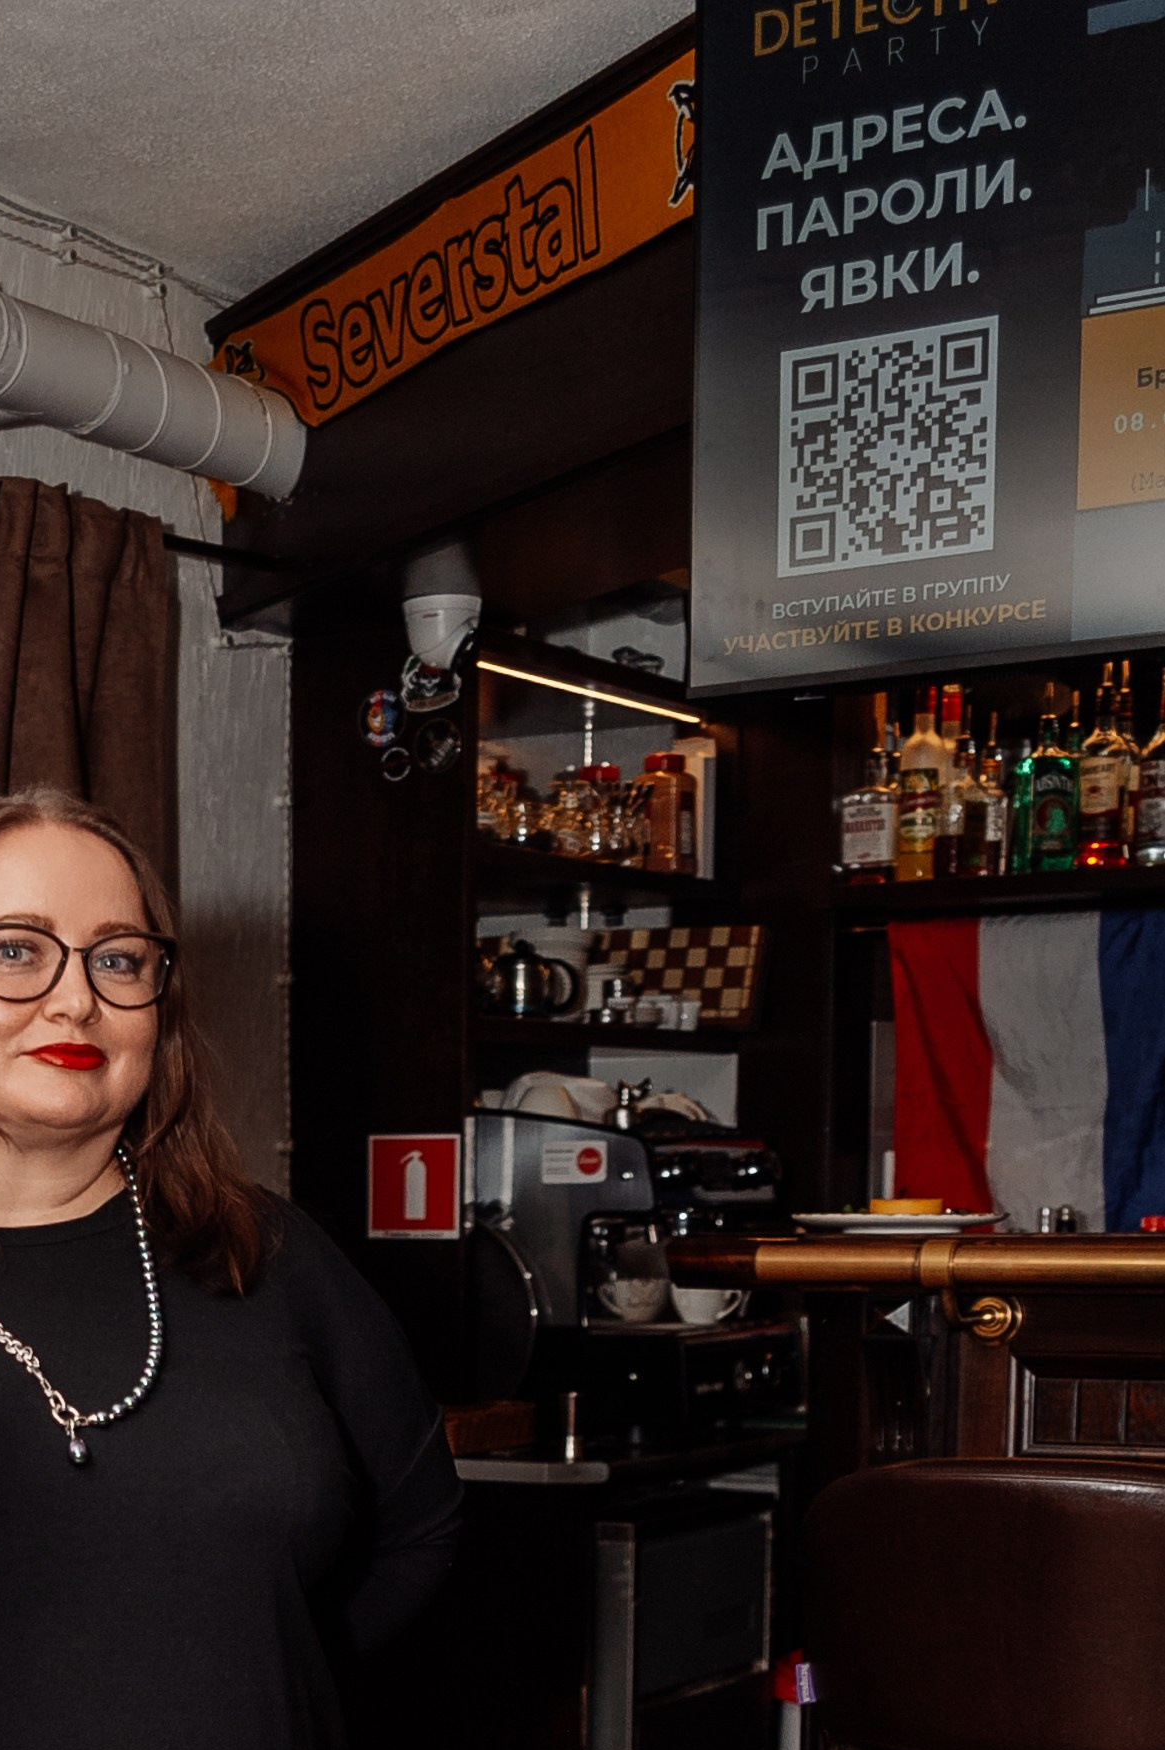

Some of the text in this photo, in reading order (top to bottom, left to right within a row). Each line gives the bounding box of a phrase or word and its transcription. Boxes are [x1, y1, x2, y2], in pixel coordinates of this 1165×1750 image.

[802, 16, 989, 84] PARTY
[761, 89, 1027, 180] АДРЕСА.
[756, 159, 1033, 251] ПАРОЛИ.
[300, 125, 600, 411] Severstal
[800, 242, 980, 313] ЯВКИ.
[724, 599, 1047, 656] УЧАСТВУЙТЕ В КОНКУРСЕ
[772, 573, 1011, 619] ВСТУПАЙТЕ В ГРУППУ
